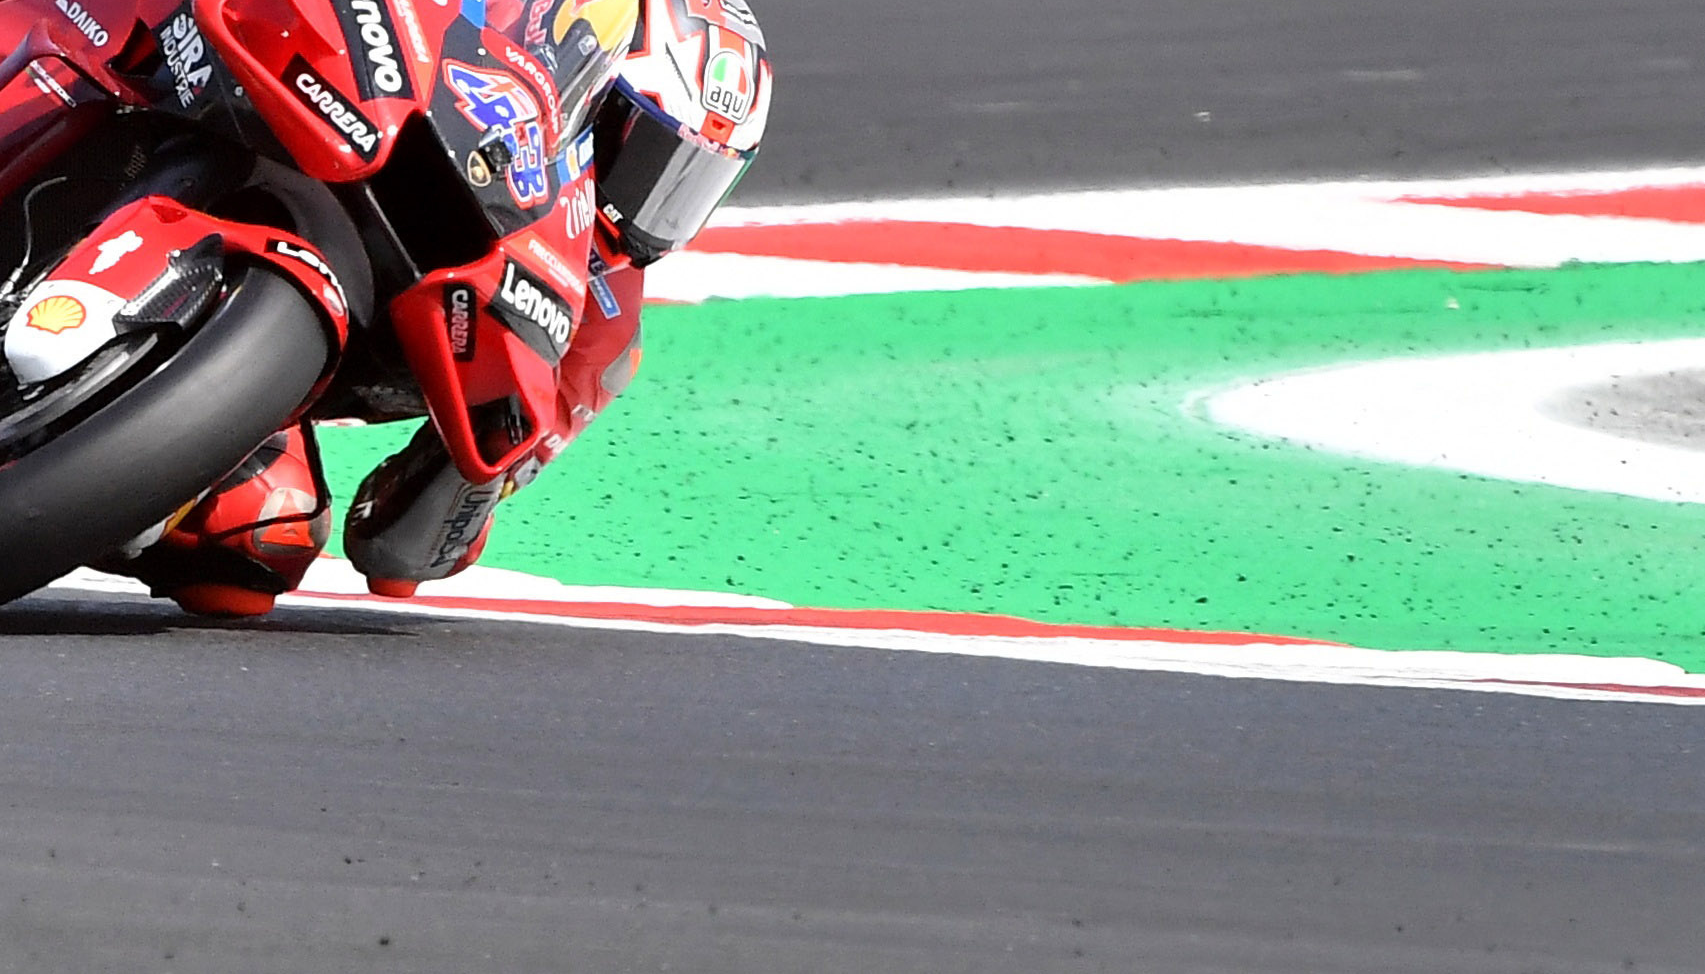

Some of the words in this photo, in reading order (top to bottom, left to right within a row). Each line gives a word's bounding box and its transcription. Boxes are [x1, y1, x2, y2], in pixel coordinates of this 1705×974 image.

[67, 1, 109, 47] DAIKO
[159, 26, 195, 109] INDUSTRIE
[296, 72, 377, 152] CARRERA
[709, 86, 745, 115] agv
[603, 204, 624, 224] CAT
[451, 289, 469, 354] CARRERA
[501, 262, 571, 343] Lenovo
